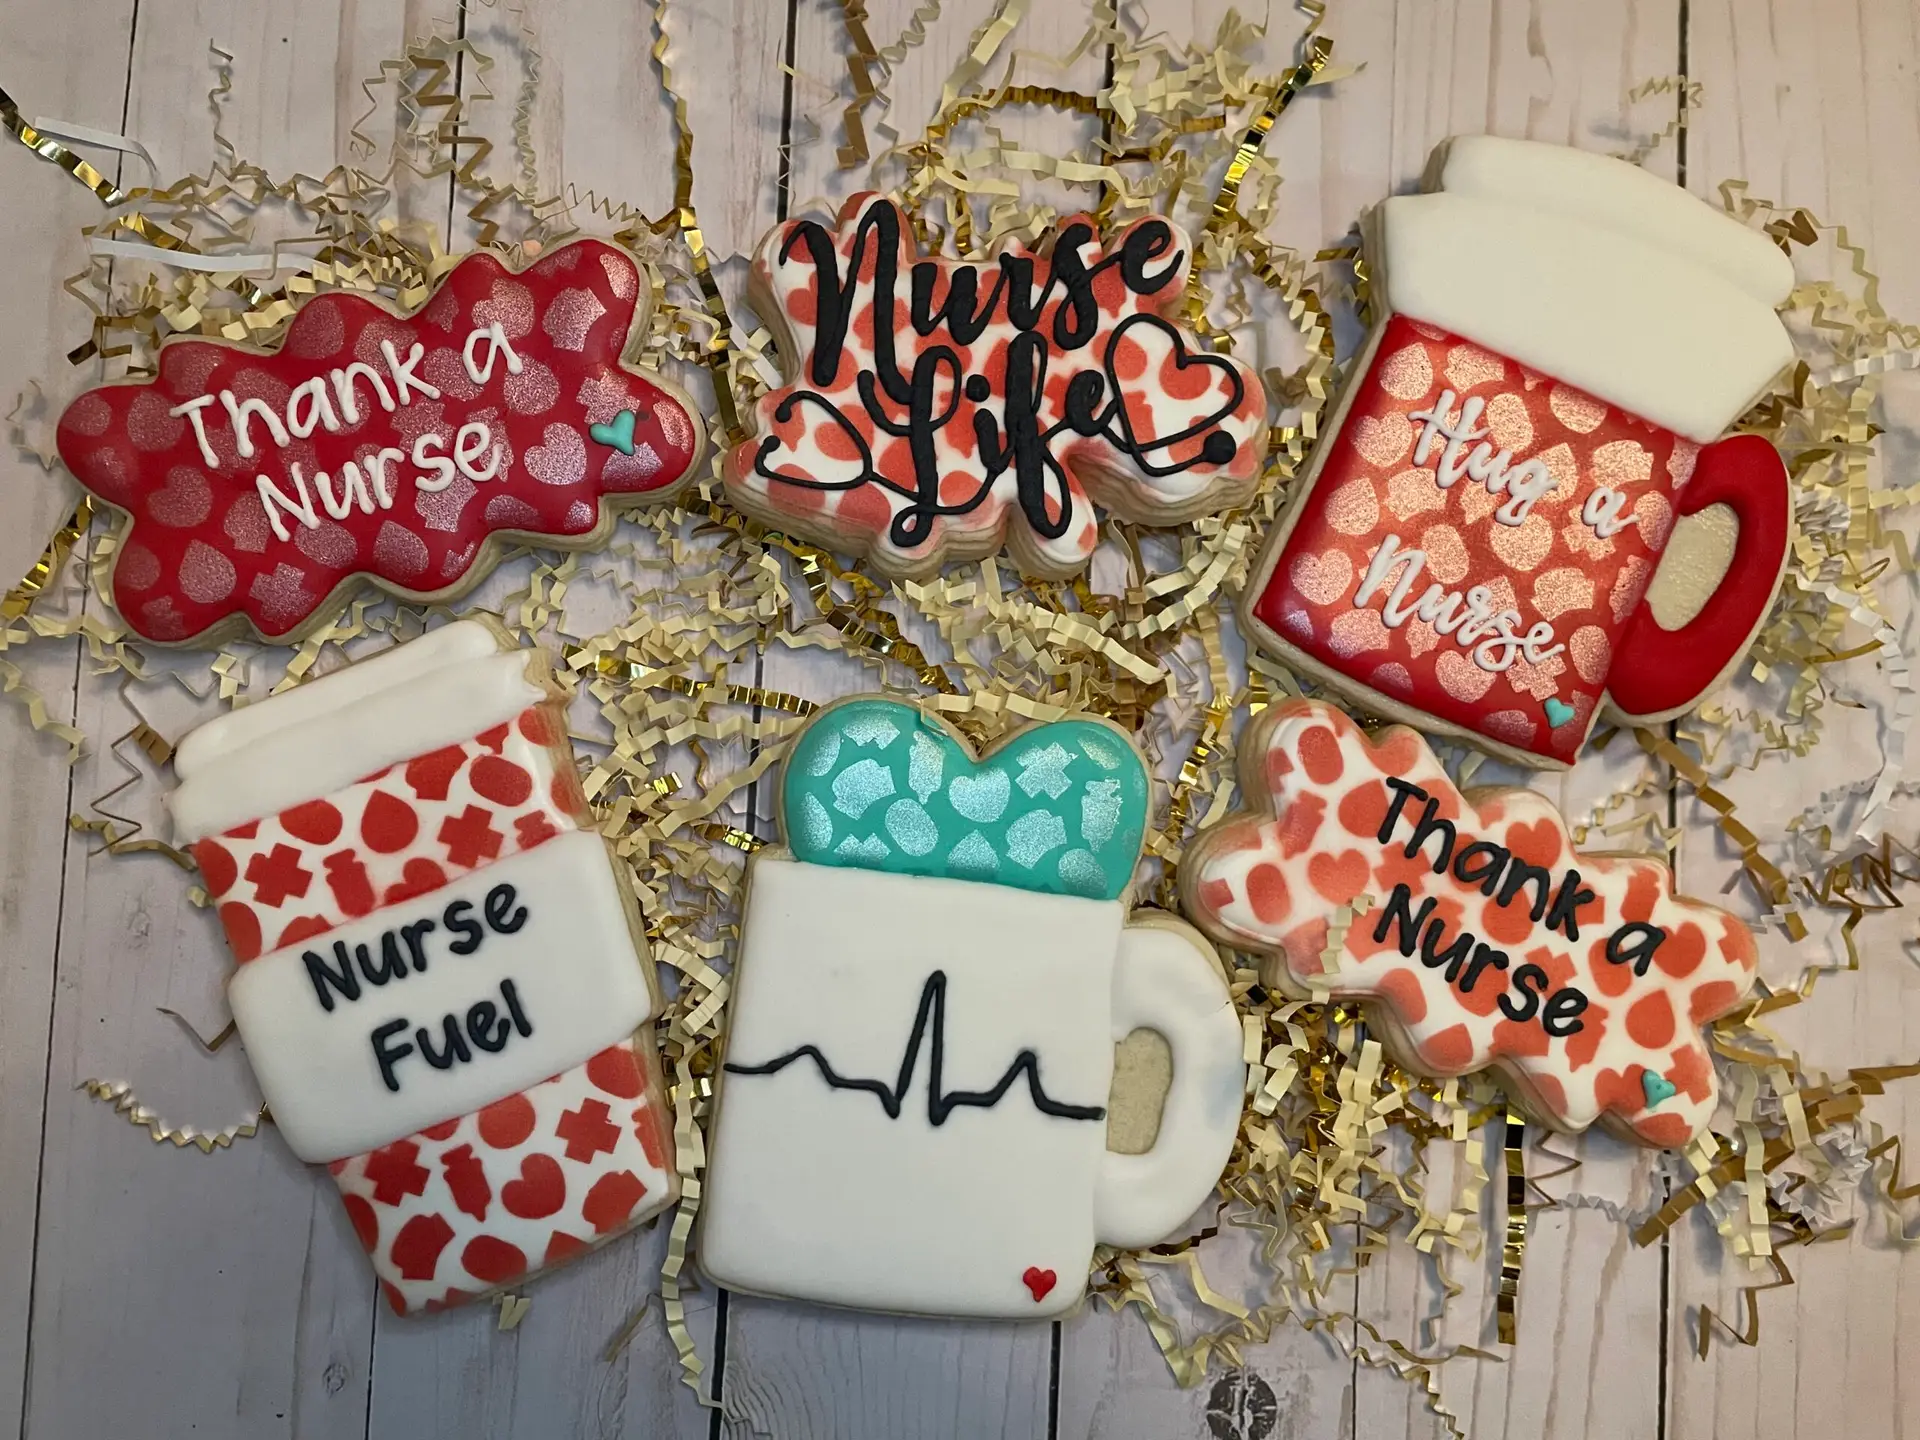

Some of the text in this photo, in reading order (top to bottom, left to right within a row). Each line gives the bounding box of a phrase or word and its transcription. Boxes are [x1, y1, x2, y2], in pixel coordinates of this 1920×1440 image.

[779, 199, 1185, 405] Nurse
[170, 321, 523, 468] Thank a
[857, 330, 1116, 548] Life
[1407, 388, 1642, 539] Hug a
[256, 421, 501, 542] Nurse
[1353, 533, 1566, 672] Nurse
[301, 883, 528, 1012] Nurse
[1376, 776, 1667, 977] Thank a
[370, 978, 533, 1092] Fuel
[1373, 883, 1589, 1038] Nurse
